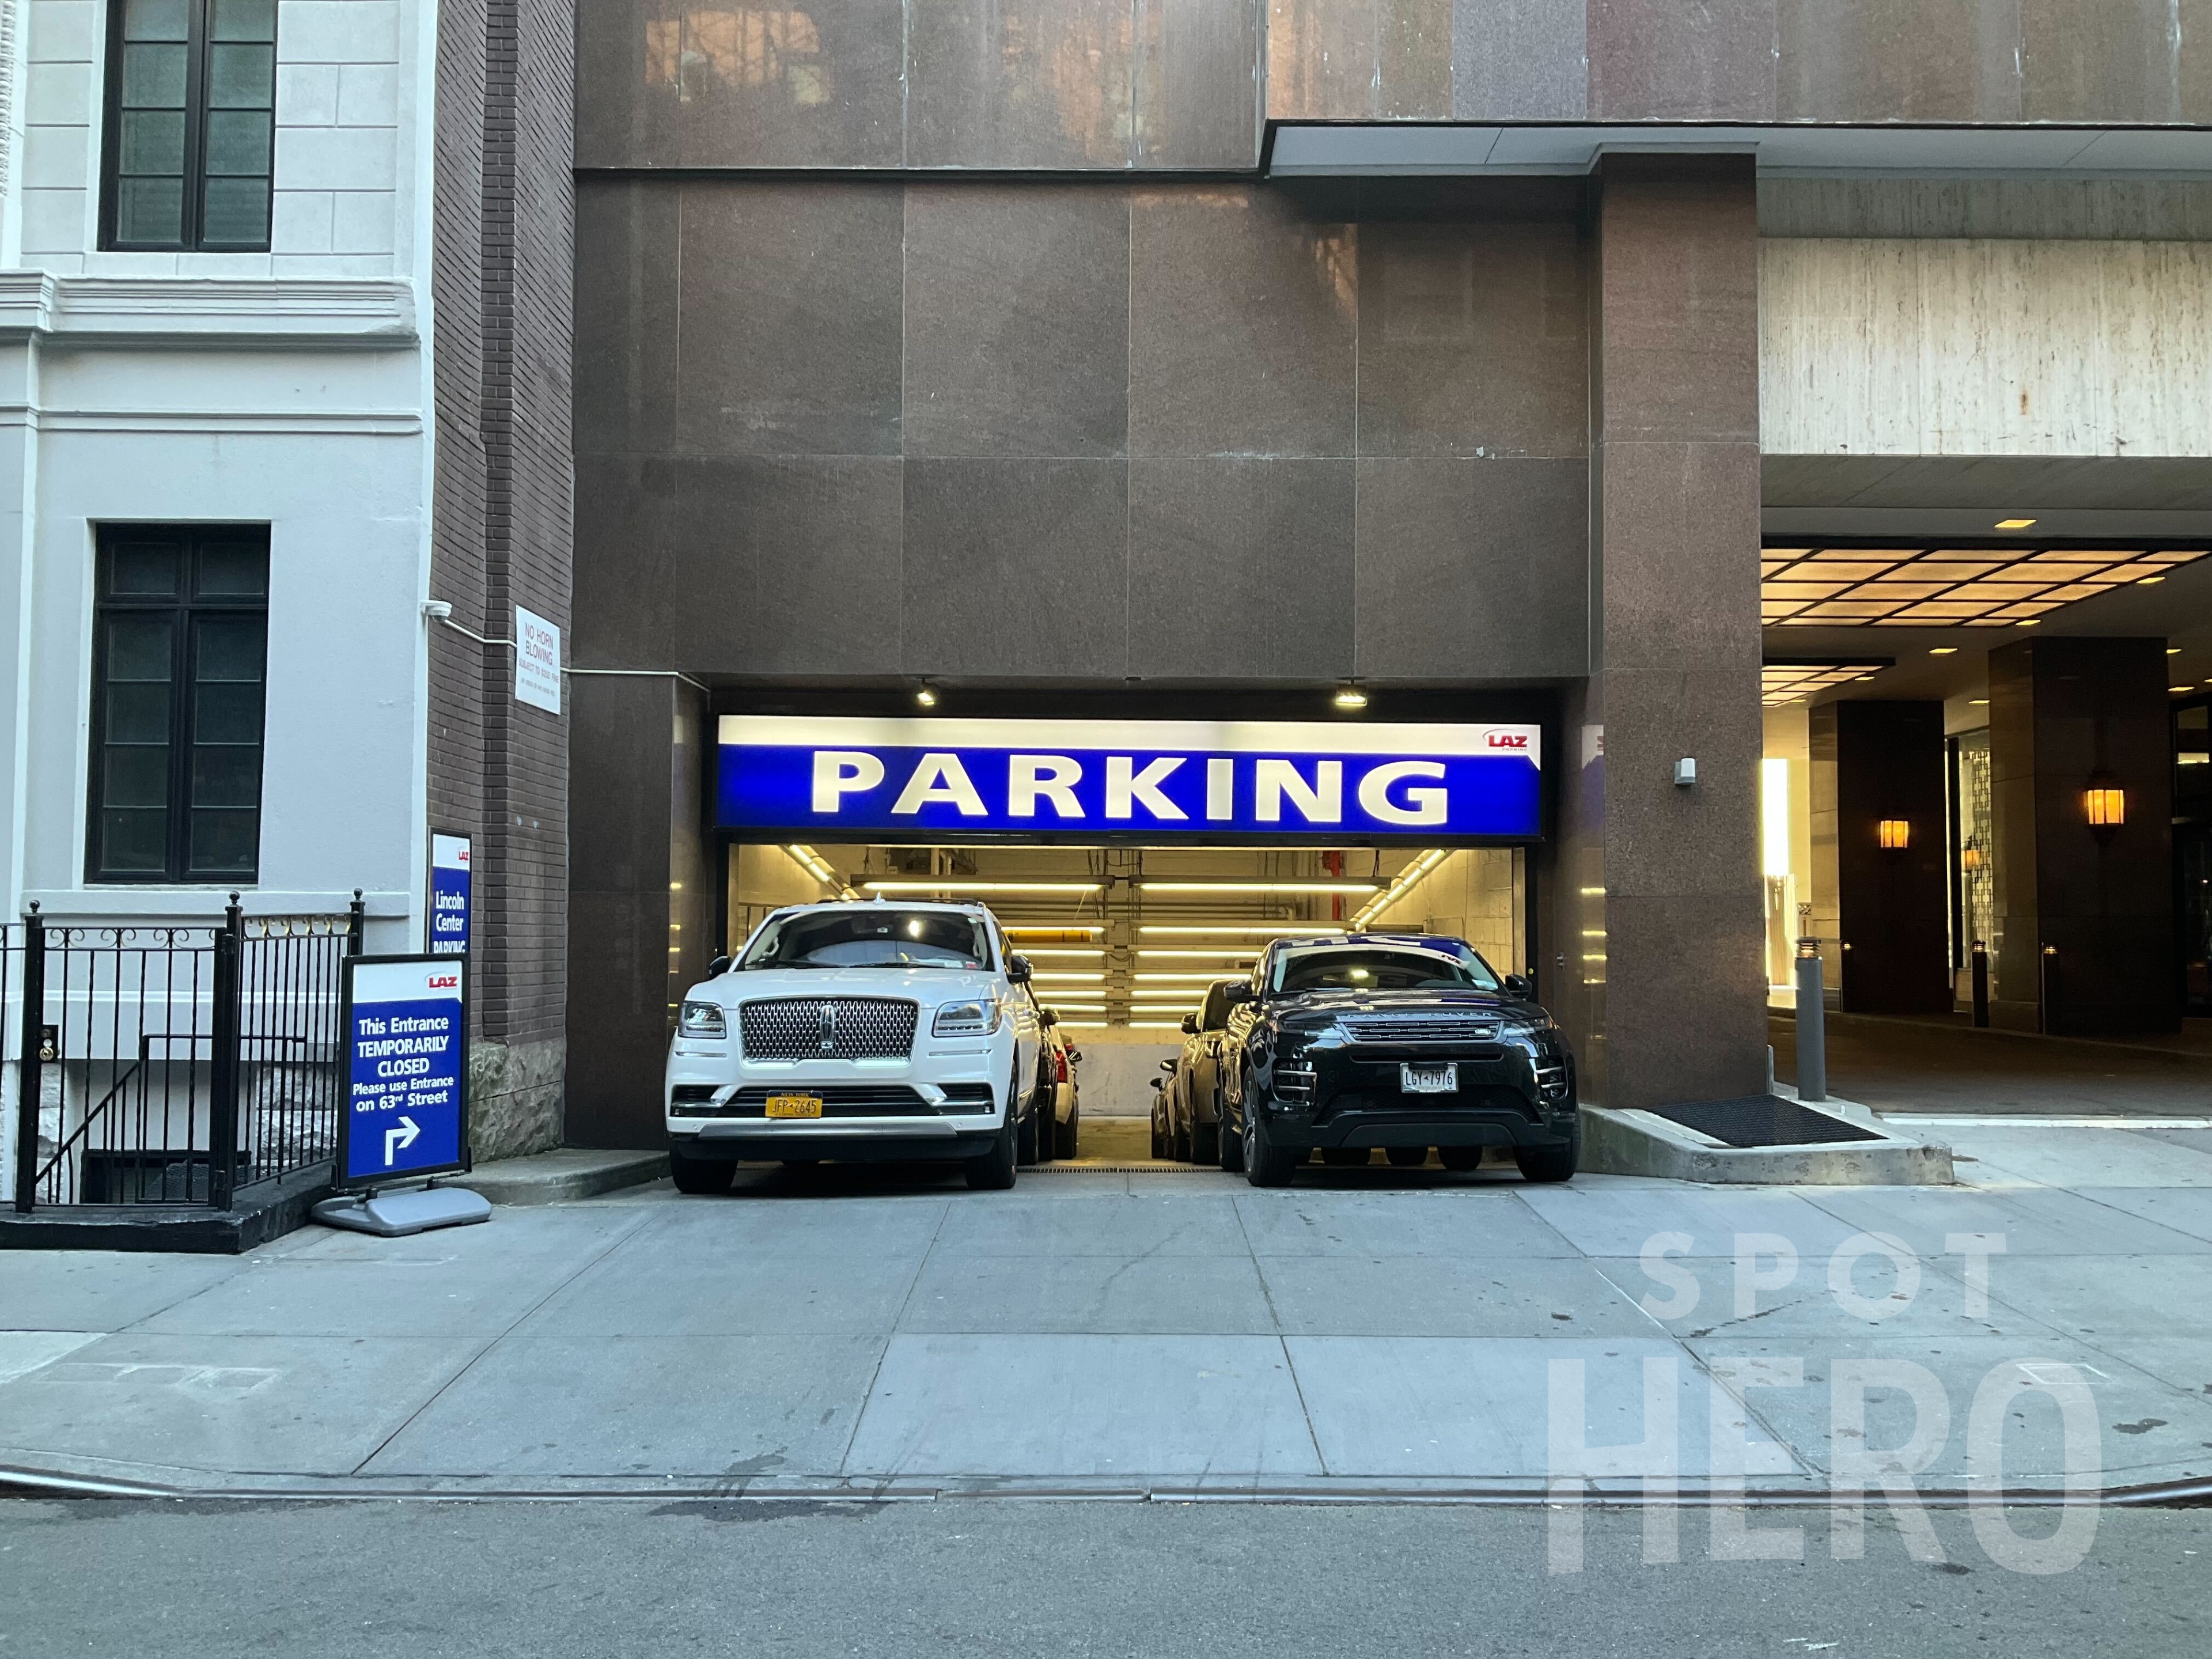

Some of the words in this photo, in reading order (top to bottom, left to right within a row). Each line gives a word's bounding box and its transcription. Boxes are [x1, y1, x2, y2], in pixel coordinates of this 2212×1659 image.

[525, 622, 535, 639] NO
[536, 628, 554, 650] HORN
[525, 640, 552, 665] BLOWING
[1488, 735, 1527, 748] LAZ
[811, 751, 1449, 826] PARKING
[459, 851, 469, 861] LAZ
[435, 890, 464, 910] Lincoln
[435, 913, 464, 931] Center
[429, 976, 457, 988] LAZ
[359, 1017, 386, 1035] This
[391, 1017, 449, 1033] Entrance
[358, 1036, 449, 1058] TEMPORARILY
[377, 1058, 430, 1077] CLOSED
[353, 1082, 386, 1095] Please
[389, 1081, 407, 1092] use
[410, 1076, 454, 1090] Entrance
[1406, 1071, 1422, 1086] LGY
[1430, 1071, 1453, 1085] 7976
[355, 1100, 375, 1112] on
[379, 1094, 403, 1109] 63rd
[407, 1090, 448, 1107] Street
[772, 1099, 789, 1112] JFP
[794, 1099, 817, 1113] 2645
